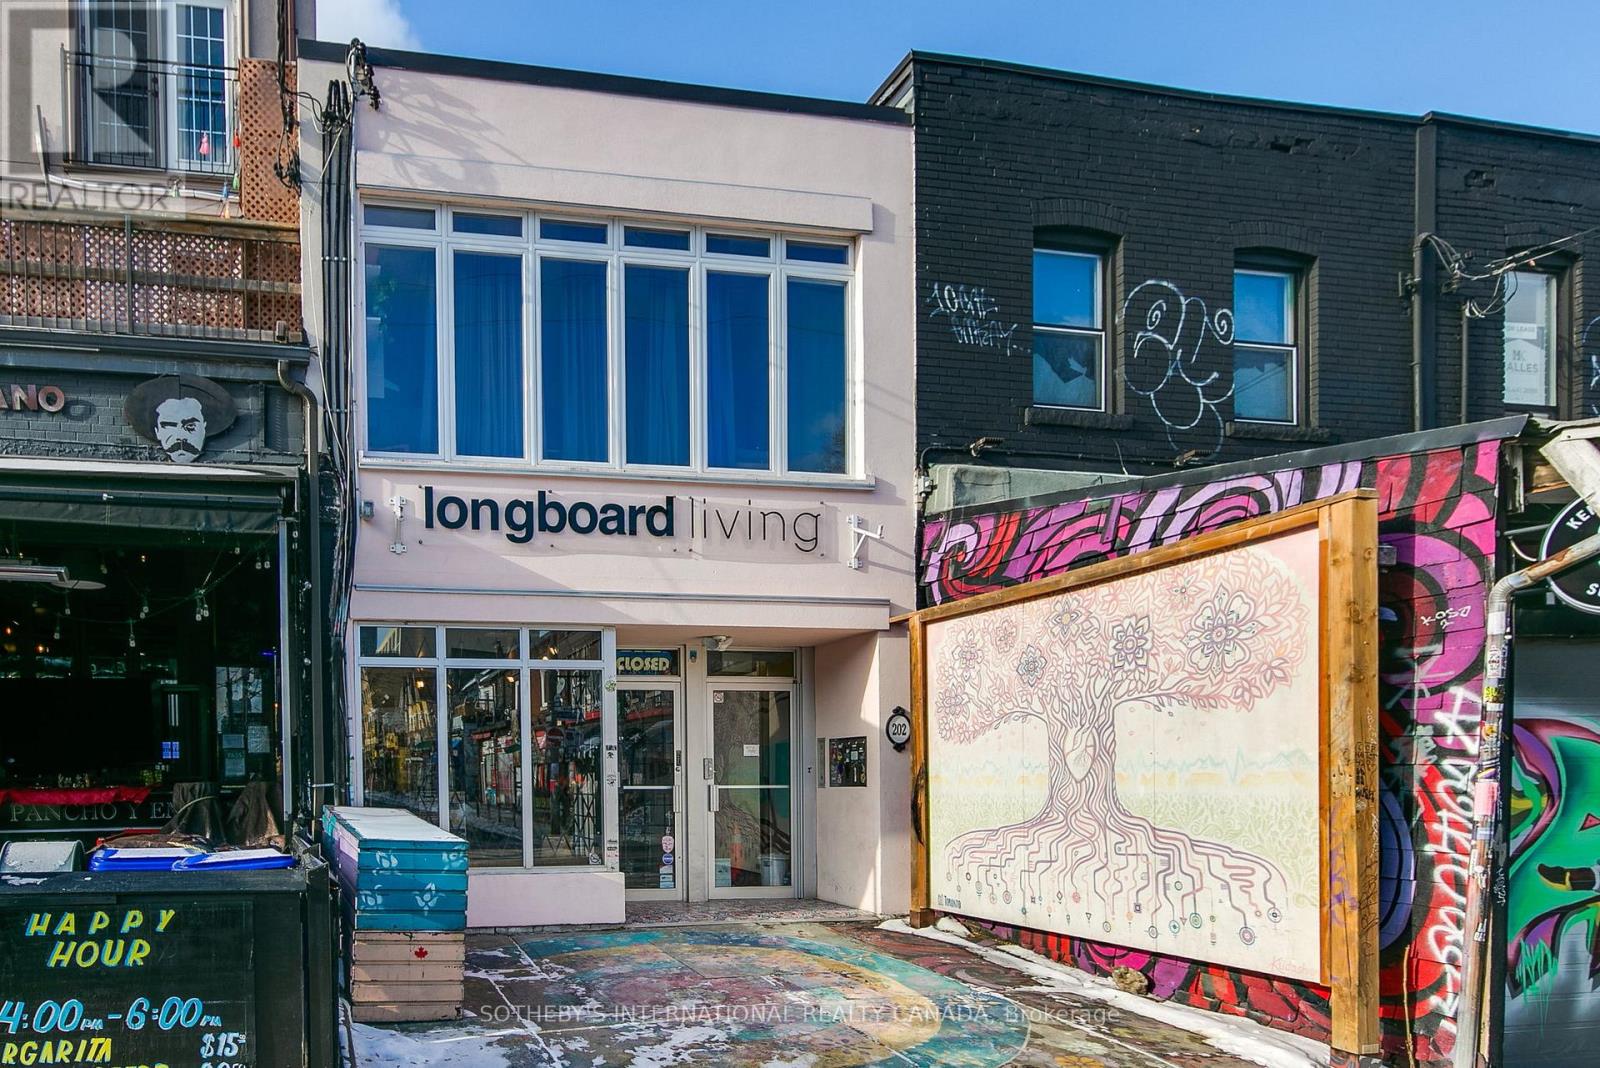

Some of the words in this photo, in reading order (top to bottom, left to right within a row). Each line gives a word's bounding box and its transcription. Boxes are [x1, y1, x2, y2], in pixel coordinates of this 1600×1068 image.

[425, 486, 674, 544] longboard
[691, 497, 821, 552] living
[616, 656, 670, 671] CLOSED
[892, 723, 907, 736] 202
[10, 802, 117, 822] PANCHO
[129, 802, 141, 820] Y
[25, 910, 175, 936] HAPPY
[47, 939, 150, 967] HOUR
[2, 1036, 113, 1066] RGARITA
